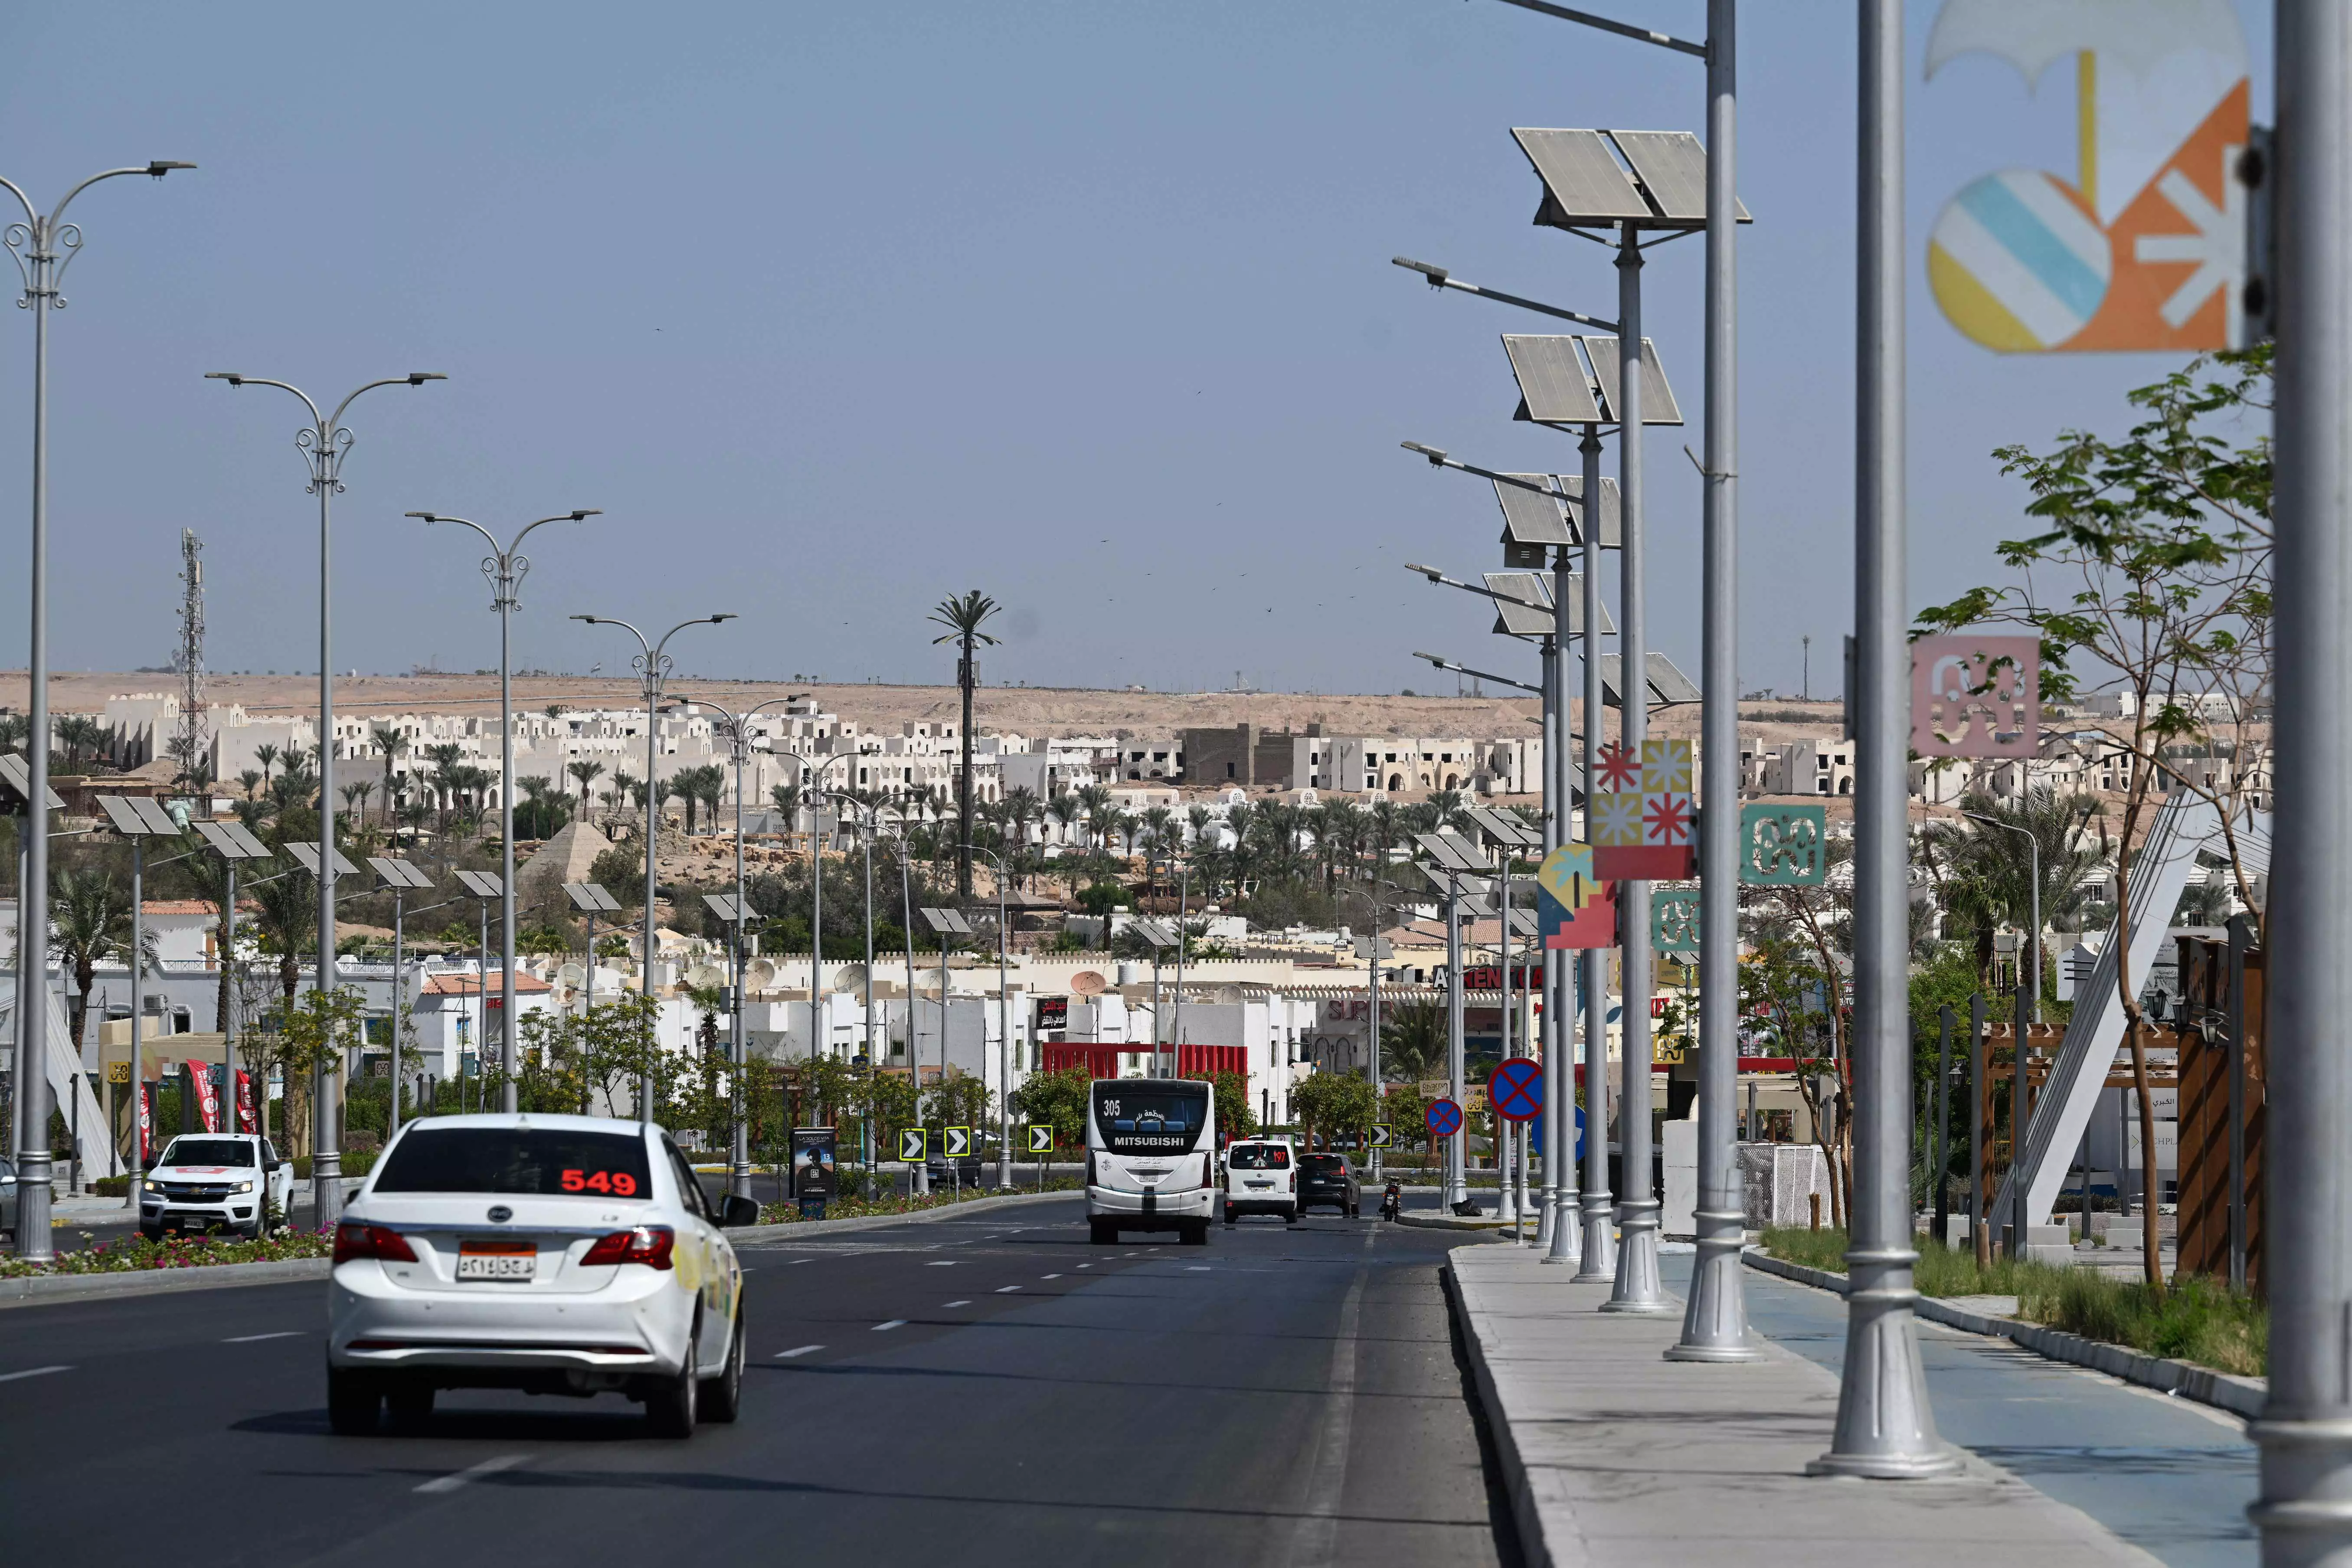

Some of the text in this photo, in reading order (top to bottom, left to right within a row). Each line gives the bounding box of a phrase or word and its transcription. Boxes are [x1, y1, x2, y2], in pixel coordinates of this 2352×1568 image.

[1104, 1100, 1120, 1116] 305
[1115, 1137, 1184, 1146] MITSUBISHI
[561, 1169, 637, 1196] 549
